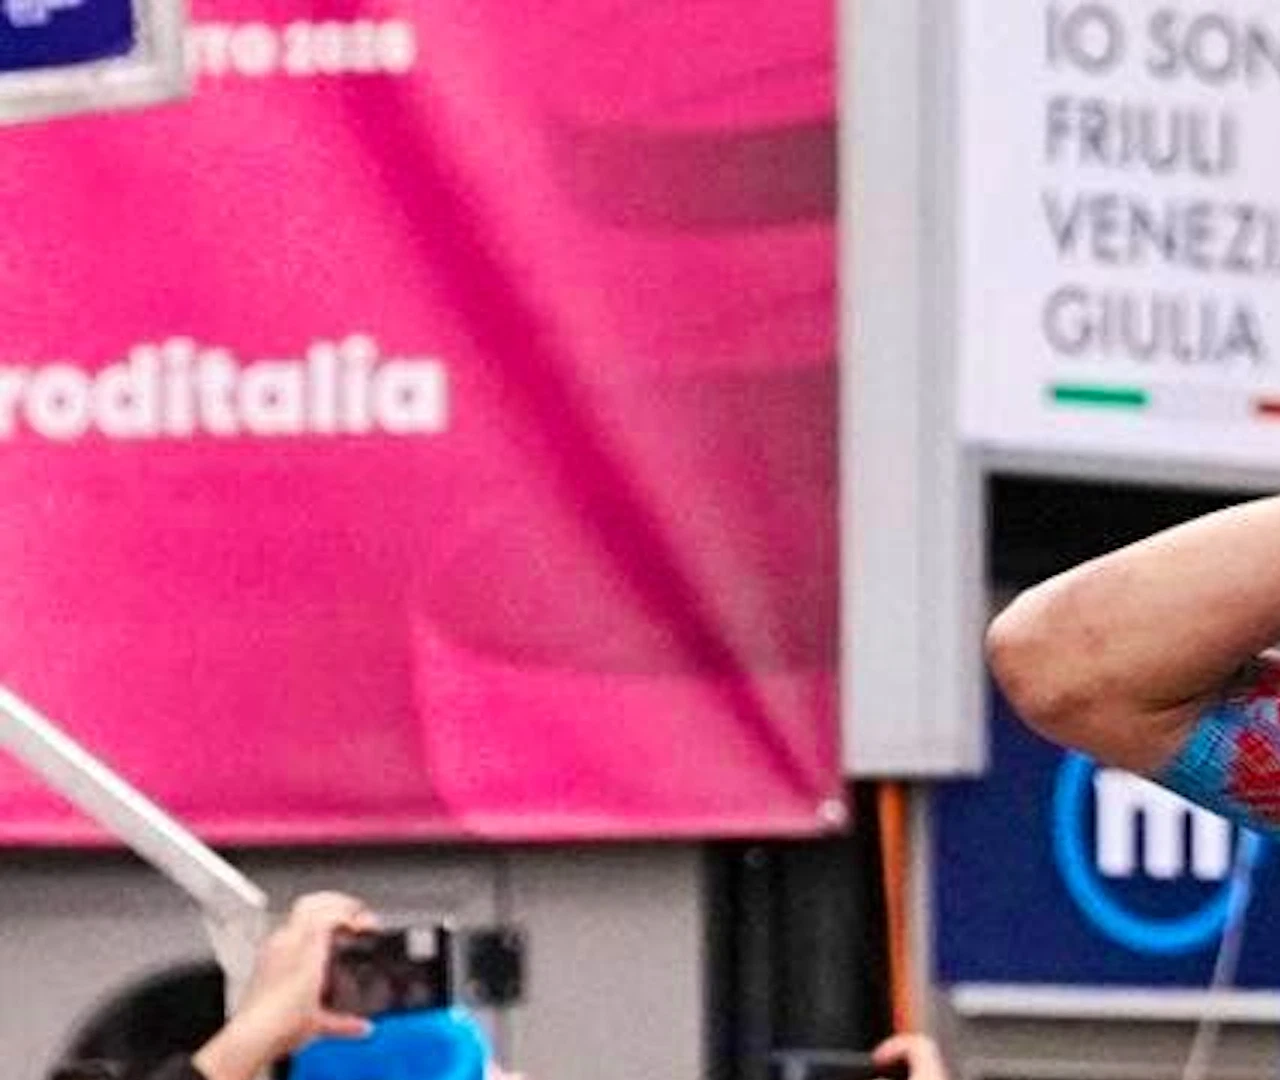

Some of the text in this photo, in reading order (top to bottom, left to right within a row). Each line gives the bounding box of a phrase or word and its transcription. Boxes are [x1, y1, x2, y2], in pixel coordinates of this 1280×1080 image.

[1046, 2, 1123, 72] IO
[1043, 97, 1240, 177] FRIULI
[1043, 286, 1267, 365] GIULIA
